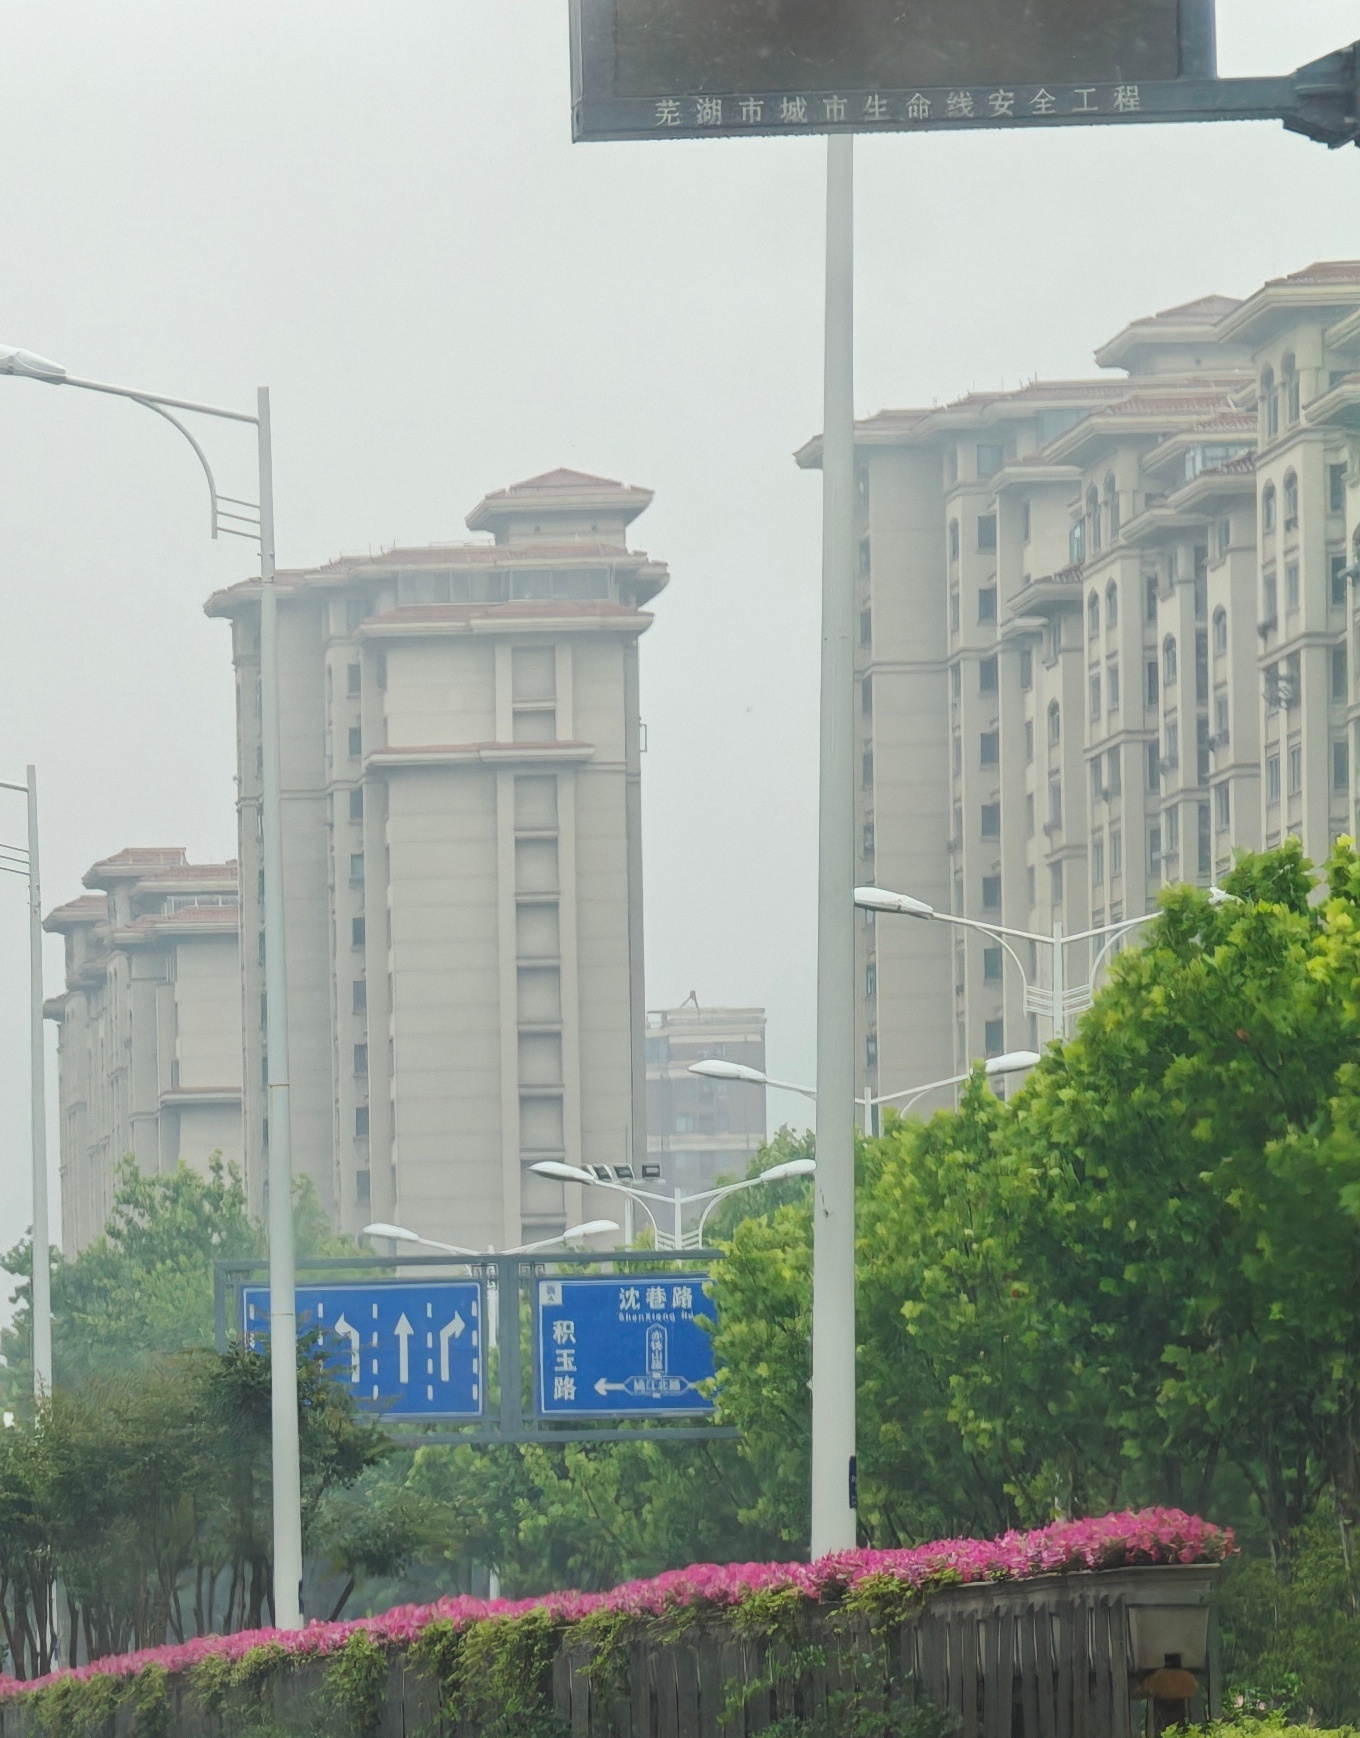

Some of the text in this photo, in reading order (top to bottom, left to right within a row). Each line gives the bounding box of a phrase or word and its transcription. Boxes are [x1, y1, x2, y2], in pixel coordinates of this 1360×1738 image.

[655, 85, 1141, 126] 芜湖市城市生命线安全工程
[619, 1286, 693, 1310] 沈巷路
[552, 1320, 577, 1401] 积玉路
